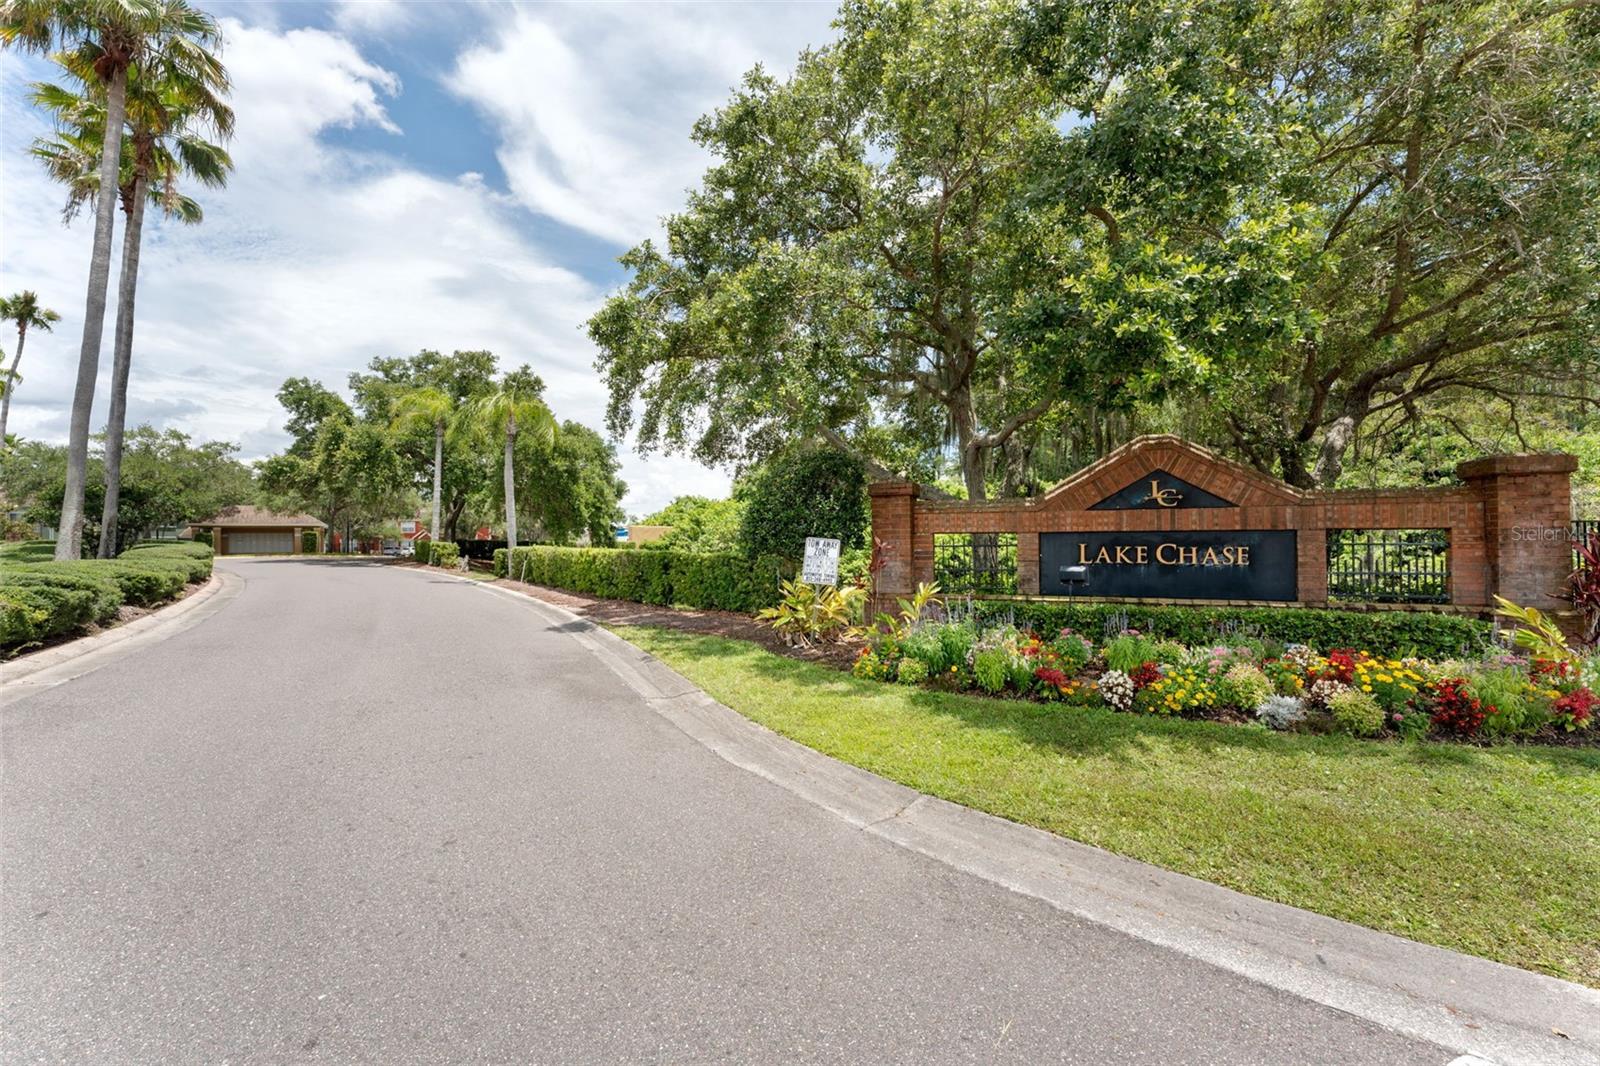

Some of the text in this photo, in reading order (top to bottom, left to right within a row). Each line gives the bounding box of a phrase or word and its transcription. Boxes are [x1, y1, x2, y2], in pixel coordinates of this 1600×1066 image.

[807, 538, 838, 549] TOW AWAY
[814, 548, 829, 557] ZONE
[1078, 543, 1250, 566] LAKE CHASE
